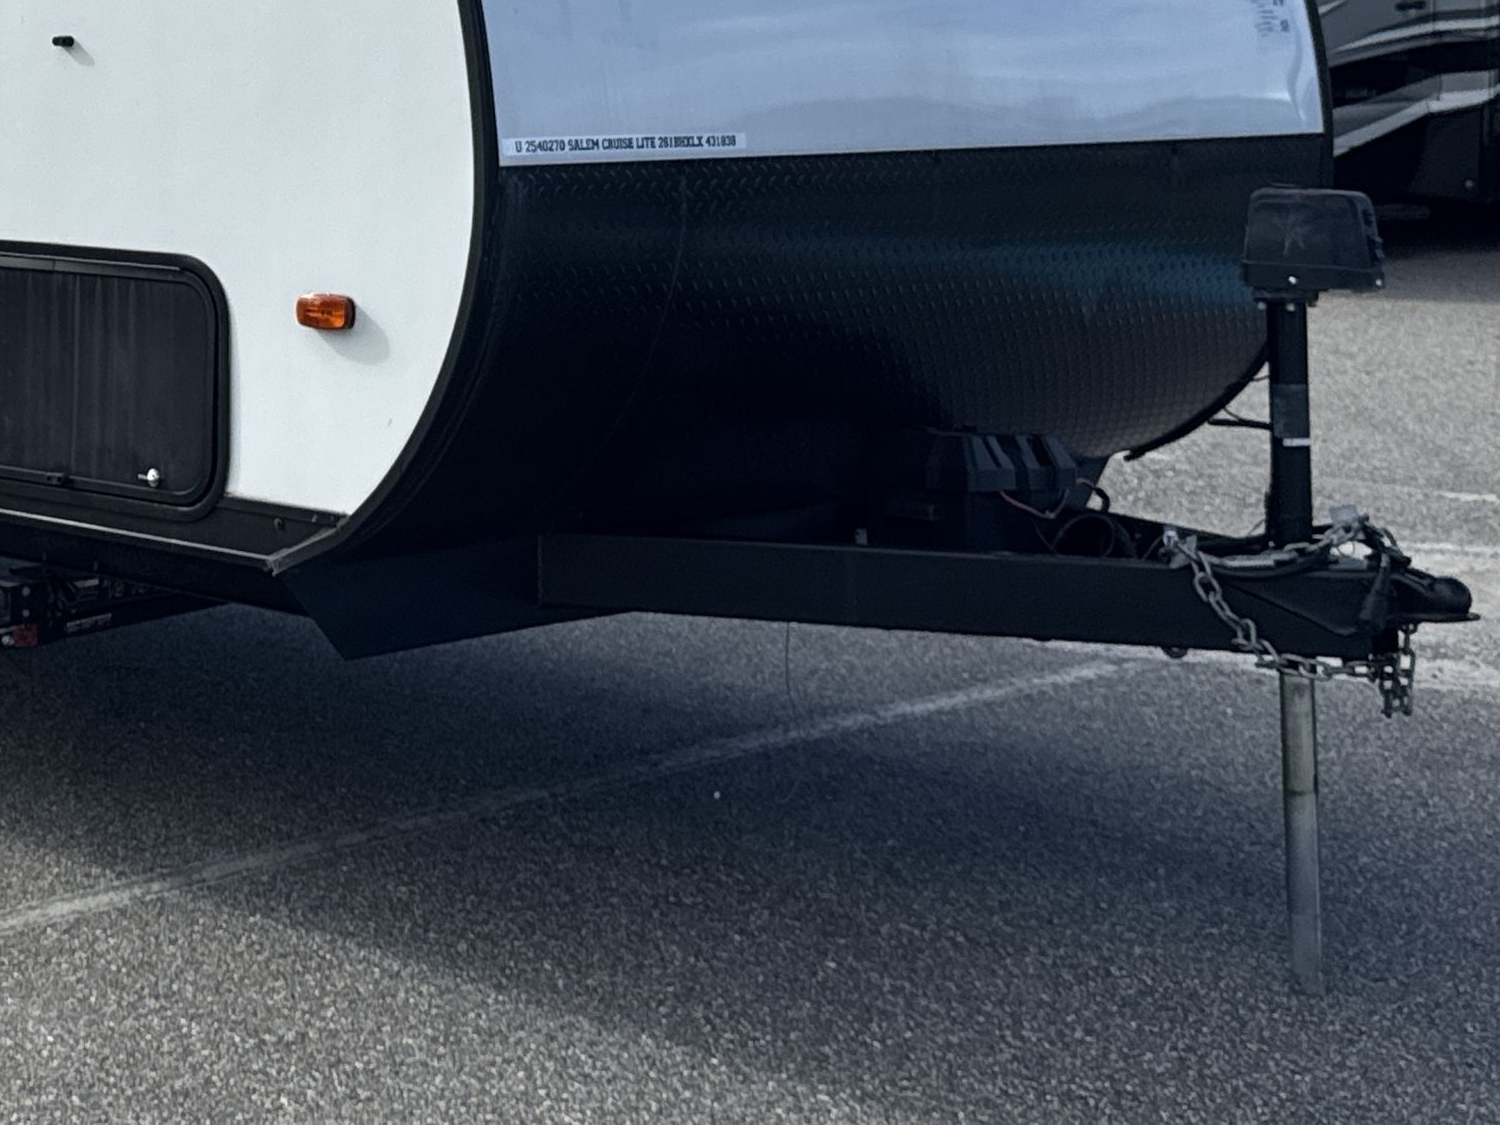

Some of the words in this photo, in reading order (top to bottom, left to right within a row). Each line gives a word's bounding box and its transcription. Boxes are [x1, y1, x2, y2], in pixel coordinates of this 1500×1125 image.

[515, 140, 523, 153] U
[525, 138, 566, 153] 2540270
[567, 138, 600, 151] SALEM
[601, 137, 634, 150] CRUISE
[635, 136, 656, 149] LITE
